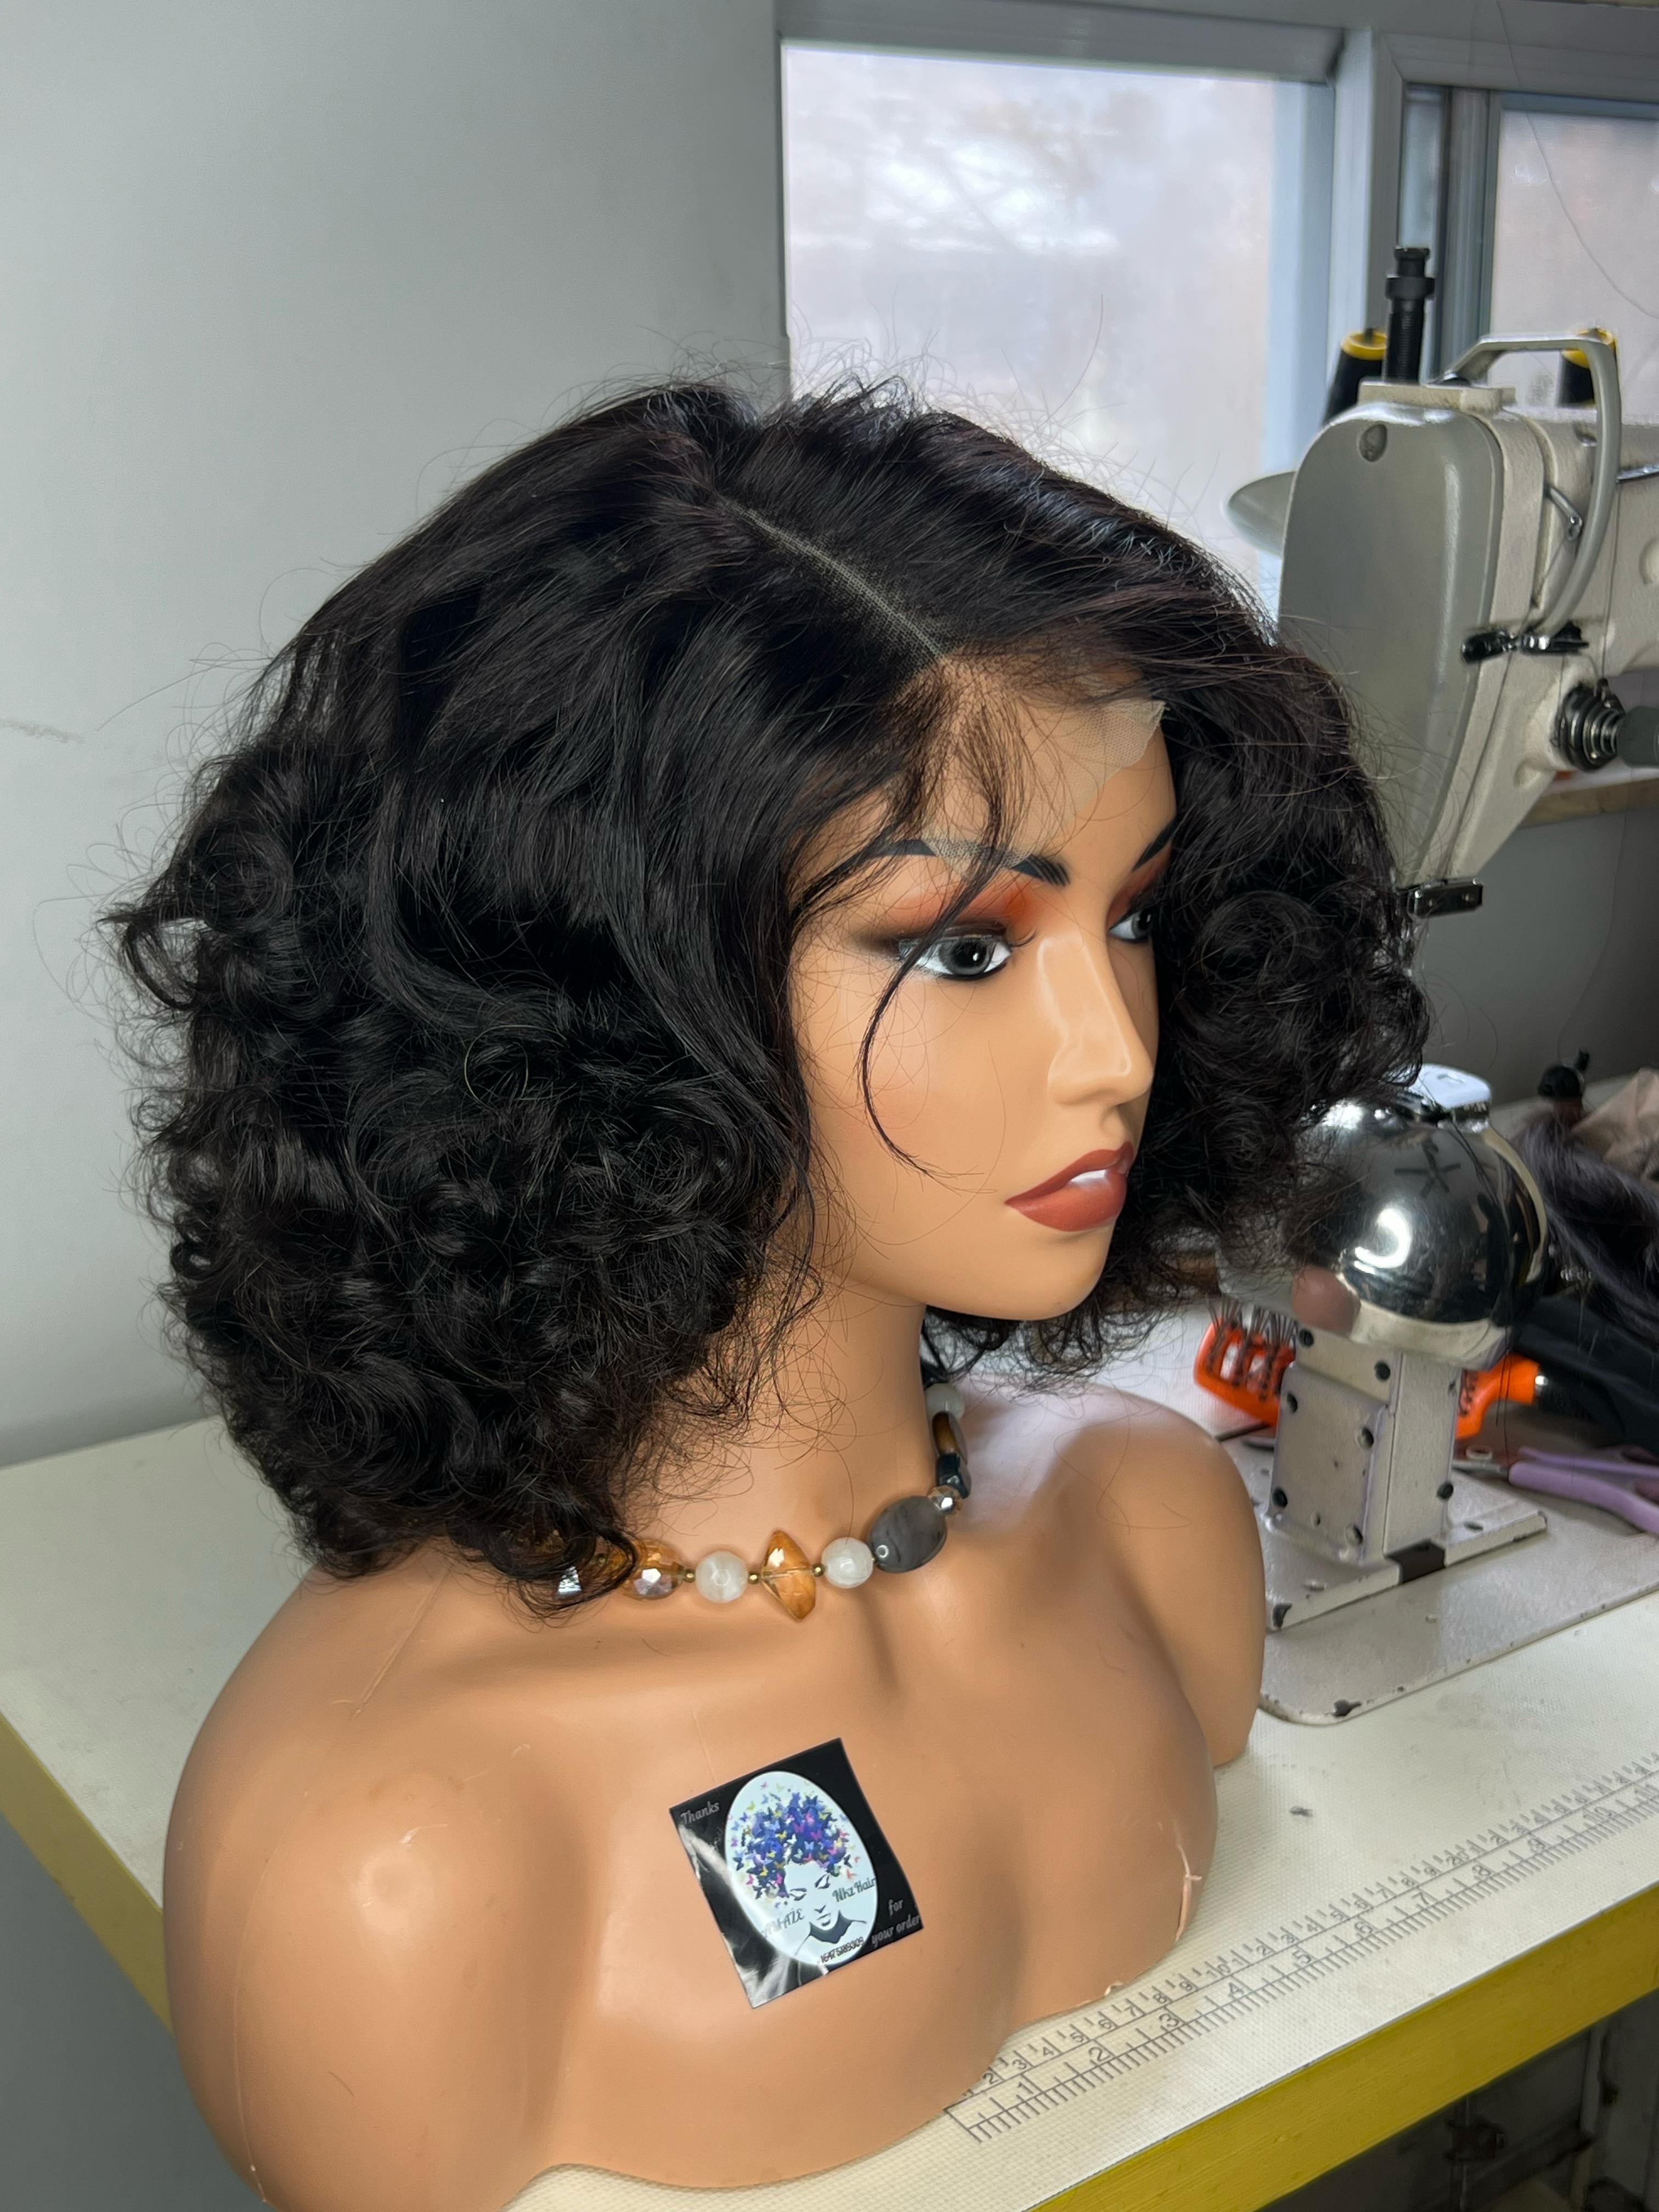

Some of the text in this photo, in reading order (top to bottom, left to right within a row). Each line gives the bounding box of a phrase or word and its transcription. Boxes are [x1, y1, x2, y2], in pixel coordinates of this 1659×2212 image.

[680, 1801, 720, 1825] Thanks
[854, 1878, 876, 1893] Hair
[889, 1899, 903, 1916] for
[871, 1914, 919, 1948] your order
[983, 2073, 999, 2084] 2
[1012, 2059, 1027, 2069] 3
[1043, 2046, 1054, 2056] 4
[1070, 2032, 1084, 2042] 5
[1098, 2019, 1112, 2029] 6
[1124, 2006, 1136, 2017] 7
[1153, 1994, 1167, 2004] 8
[1179, 1981, 1193, 1991] 9
[1206, 1963, 1231, 1977] 10
[1256, 1945, 1268, 1956] 2
[1281, 1933, 1295, 1943] 3
[1307, 1923, 1318, 1933] 4
[1330, 1911, 1344, 1920] 5
[1354, 1899, 1368, 1909] 6
[1376, 1888, 1388, 1898] 7
[1401, 1878, 1415, 1887] 8
[1424, 1866, 1437, 1876] 9
[1018, 2082, 1034, 2095] 1
[1088, 2047, 1110, 2062] 2
[1159, 2013, 1179, 2027] 3
[1228, 1983, 1245, 1997] 4
[1293, 1949, 1311, 1963] 5
[1354, 1921, 1373, 1934] 6
[1412, 1892, 1429, 1905] 7
[1472, 1864, 1492, 1876] 8
[1528, 1838, 1546, 1853] 9
